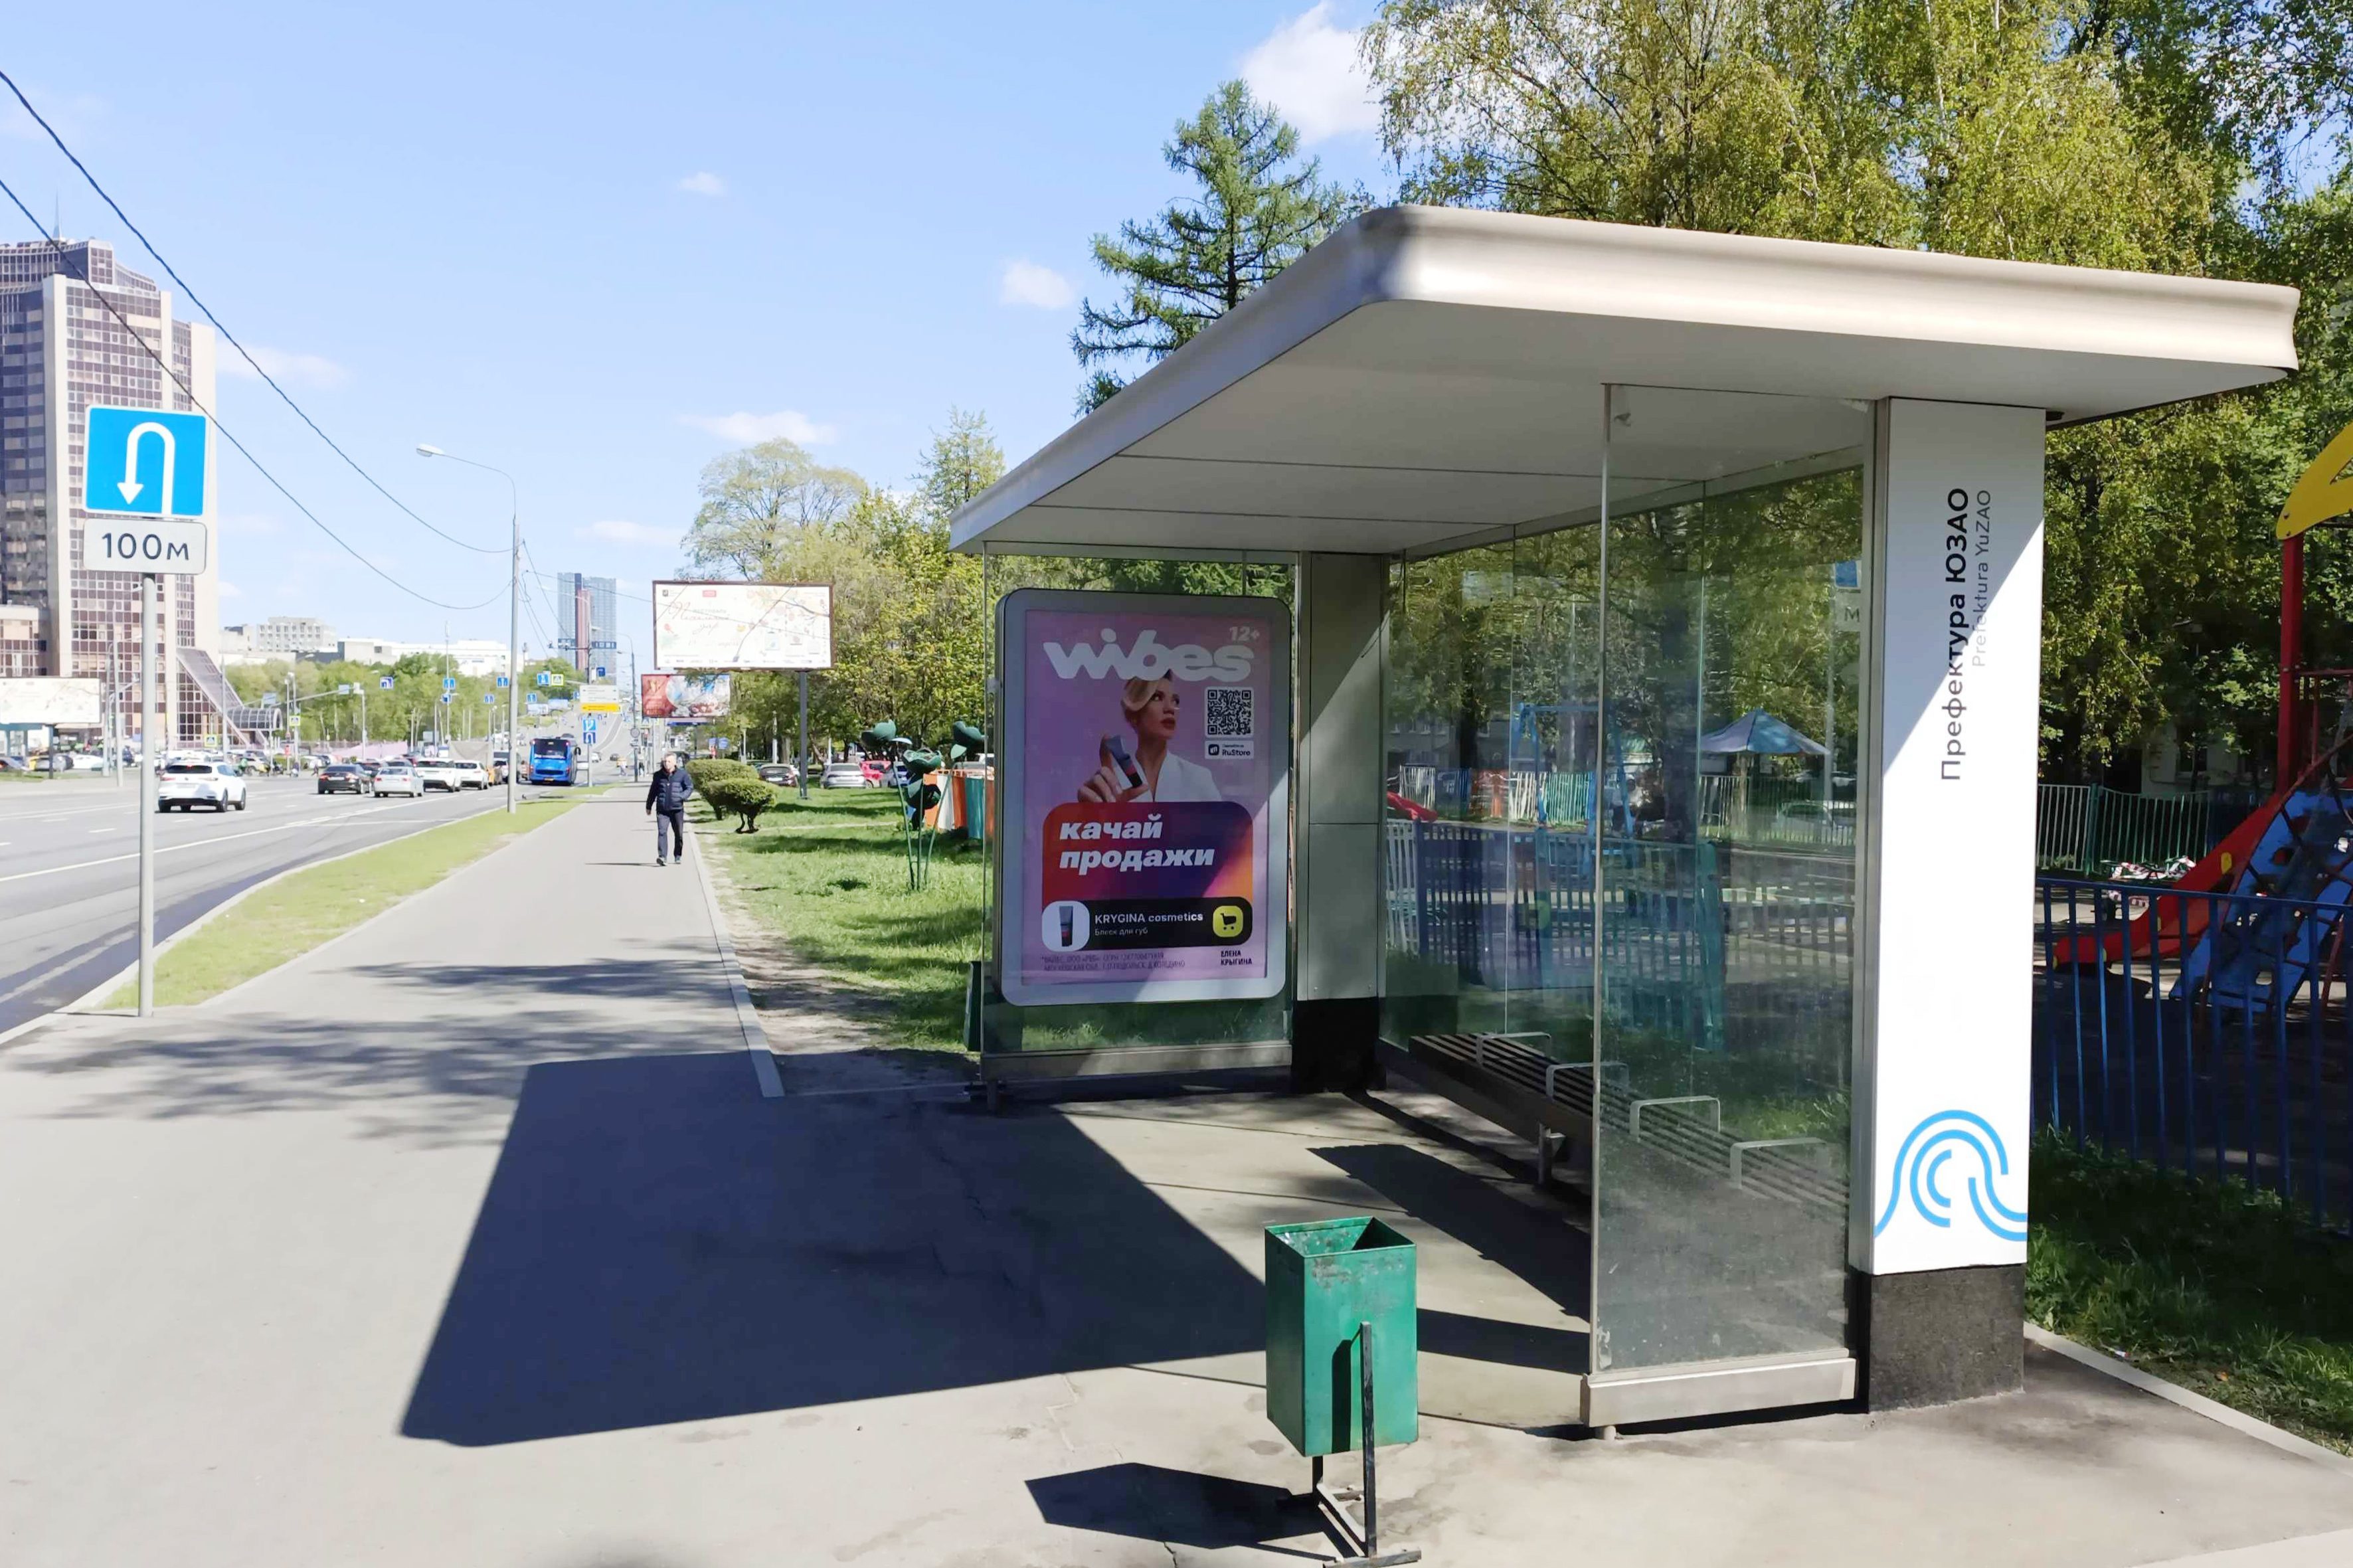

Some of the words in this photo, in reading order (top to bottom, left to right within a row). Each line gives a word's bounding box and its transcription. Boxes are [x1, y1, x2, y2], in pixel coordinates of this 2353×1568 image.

[1945, 487, 1969, 582] ЮЗАО
[1974, 489, 1991, 557] YuZAO
[1972, 563, 1988, 667] Prefektura
[1229, 626, 1260, 642] 12+
[1043, 628, 1255, 682] wibes
[1941, 593, 1970, 781] Префектура
[1059, 813, 1163, 840] качай
[1059, 849, 1215, 875] продажи
[1094, 913, 1146, 924] KRYGINA
[1148, 912, 1204, 922] cosmetics
[1135, 926, 1148, 936] губ
[1221, 958, 1253, 966] КРЫГИНА
